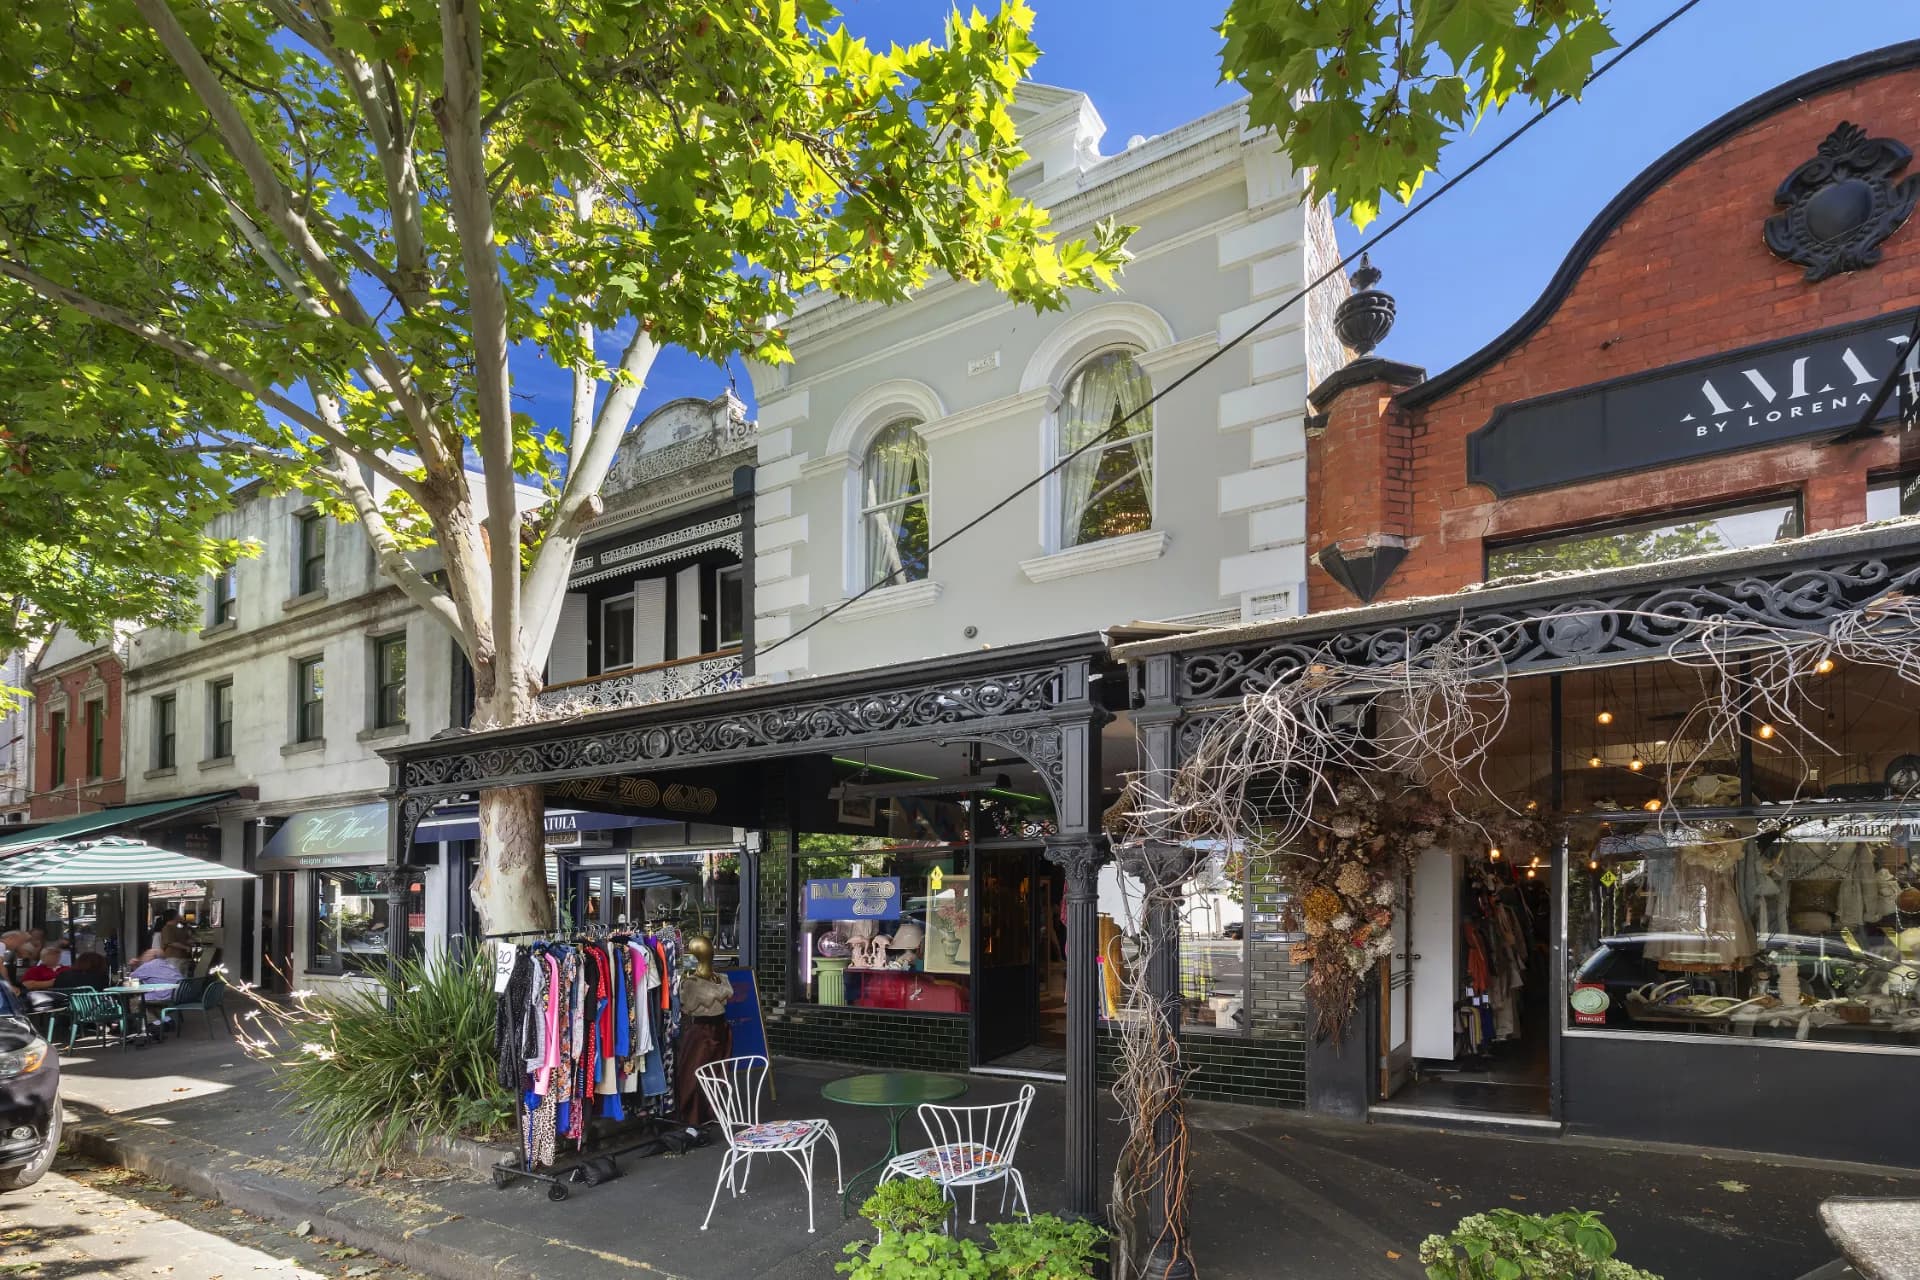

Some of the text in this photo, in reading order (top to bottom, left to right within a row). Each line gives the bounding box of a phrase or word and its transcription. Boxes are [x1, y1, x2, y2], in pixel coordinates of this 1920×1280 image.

[1696, 420, 1728, 437] BY
[1748, 392, 1872, 427] LORENA
[662, 782, 718, 816] 629
